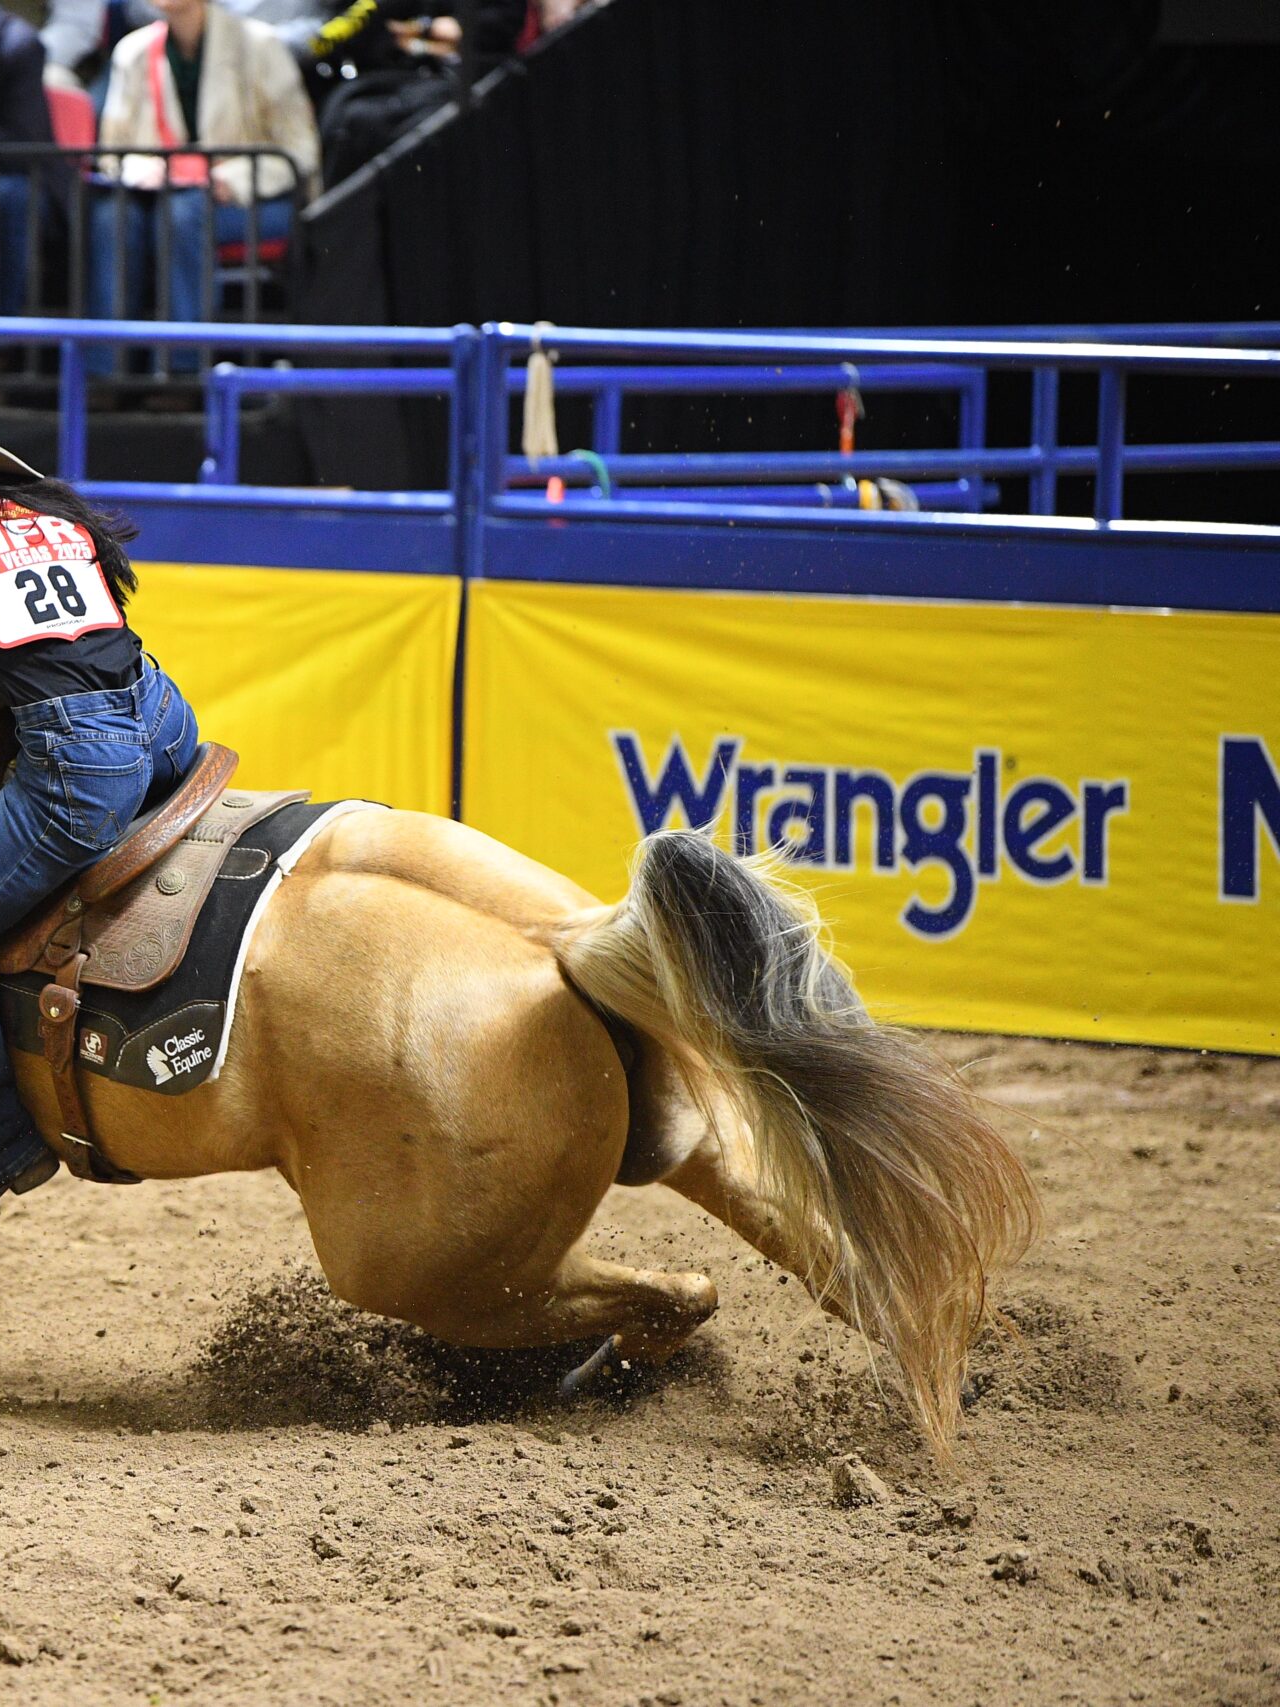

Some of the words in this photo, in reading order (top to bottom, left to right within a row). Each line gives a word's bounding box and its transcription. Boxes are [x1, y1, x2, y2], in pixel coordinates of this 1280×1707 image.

[0, 545, 52, 570] VEGAS
[53, 541, 94, 561] 2025
[14, 565, 87, 625] 28
[609, 729, 1128, 943] Wrangler
[164, 1027, 206, 1058] Classic
[170, 1045, 213, 1077] Equine
